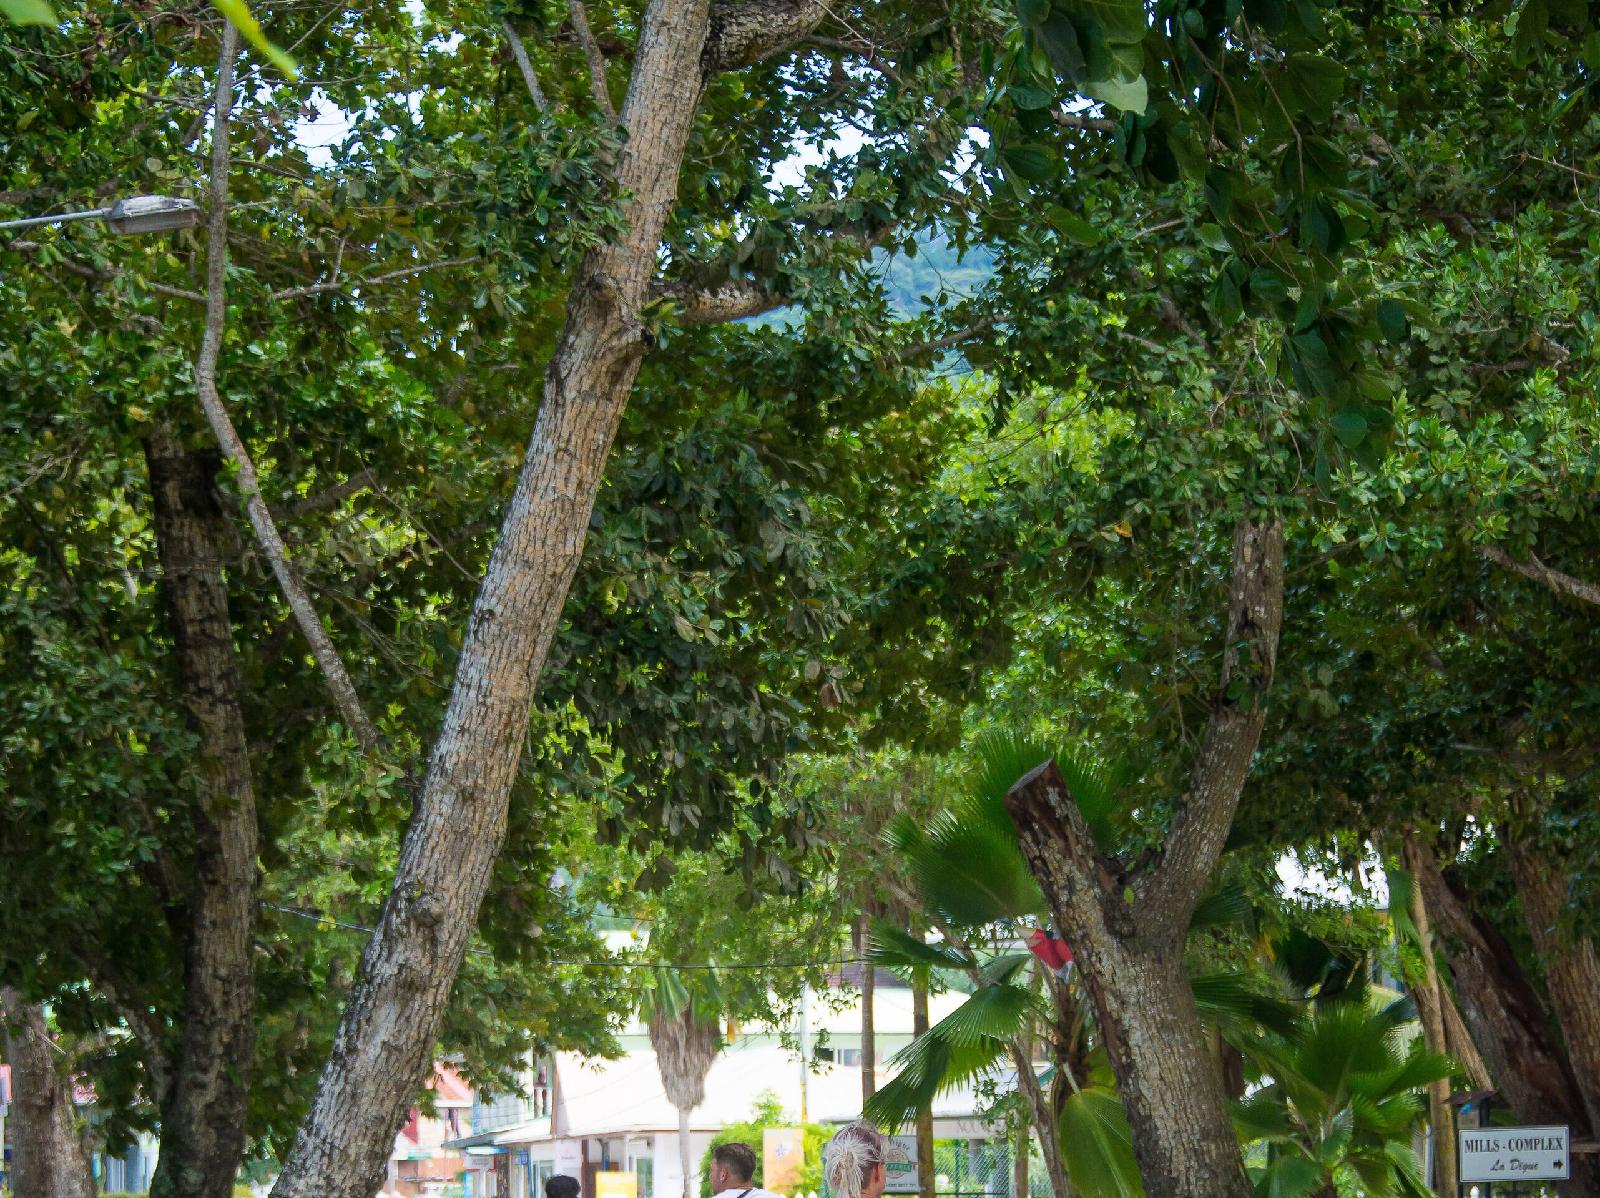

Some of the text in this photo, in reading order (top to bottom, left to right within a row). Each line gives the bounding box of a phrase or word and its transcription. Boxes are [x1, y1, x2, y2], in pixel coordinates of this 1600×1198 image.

[1464, 1139, 1500, 1153] MILLS
[1508, 1137, 1563, 1152] COMPLEX
[1490, 1159, 1539, 1174] La Digue
